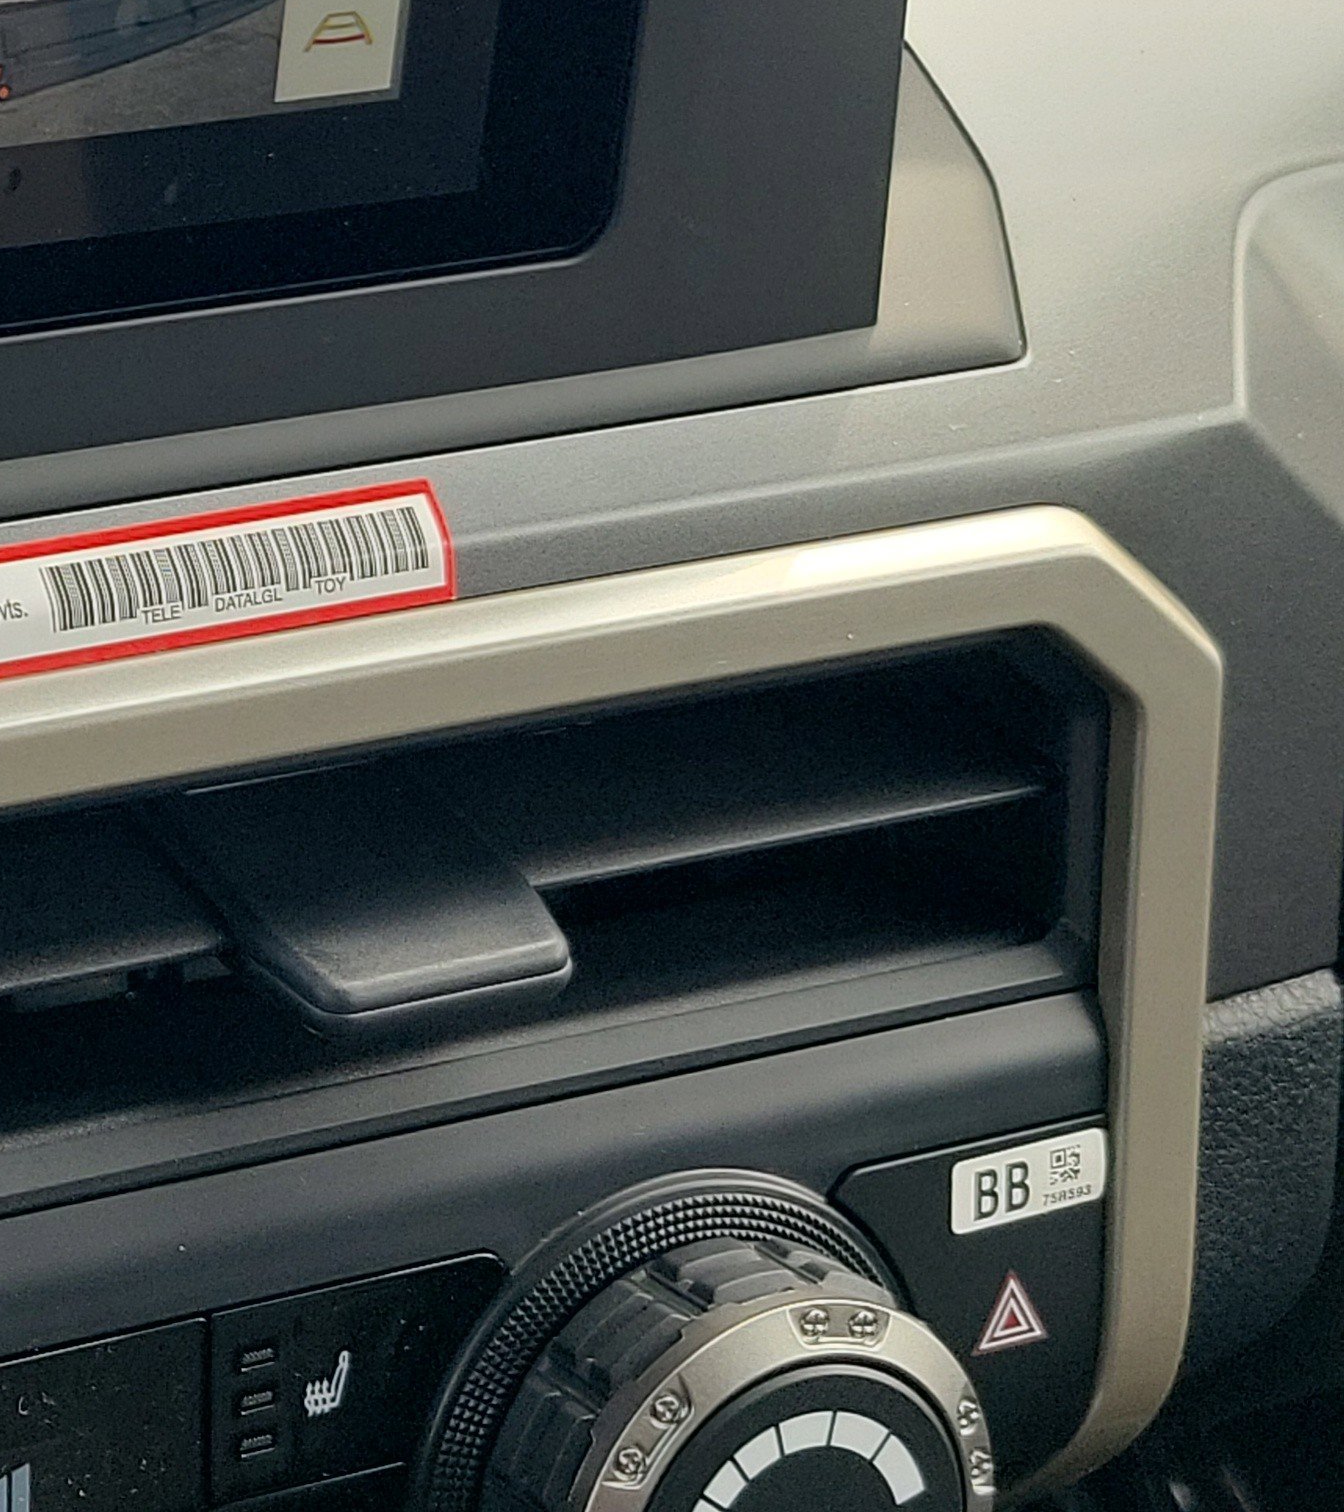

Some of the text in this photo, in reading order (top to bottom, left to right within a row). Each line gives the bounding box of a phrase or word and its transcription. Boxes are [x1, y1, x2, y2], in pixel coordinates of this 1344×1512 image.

[141, 576, 347, 626] TELE DATALGL TOY
[973, 1160, 1031, 1221] BB
